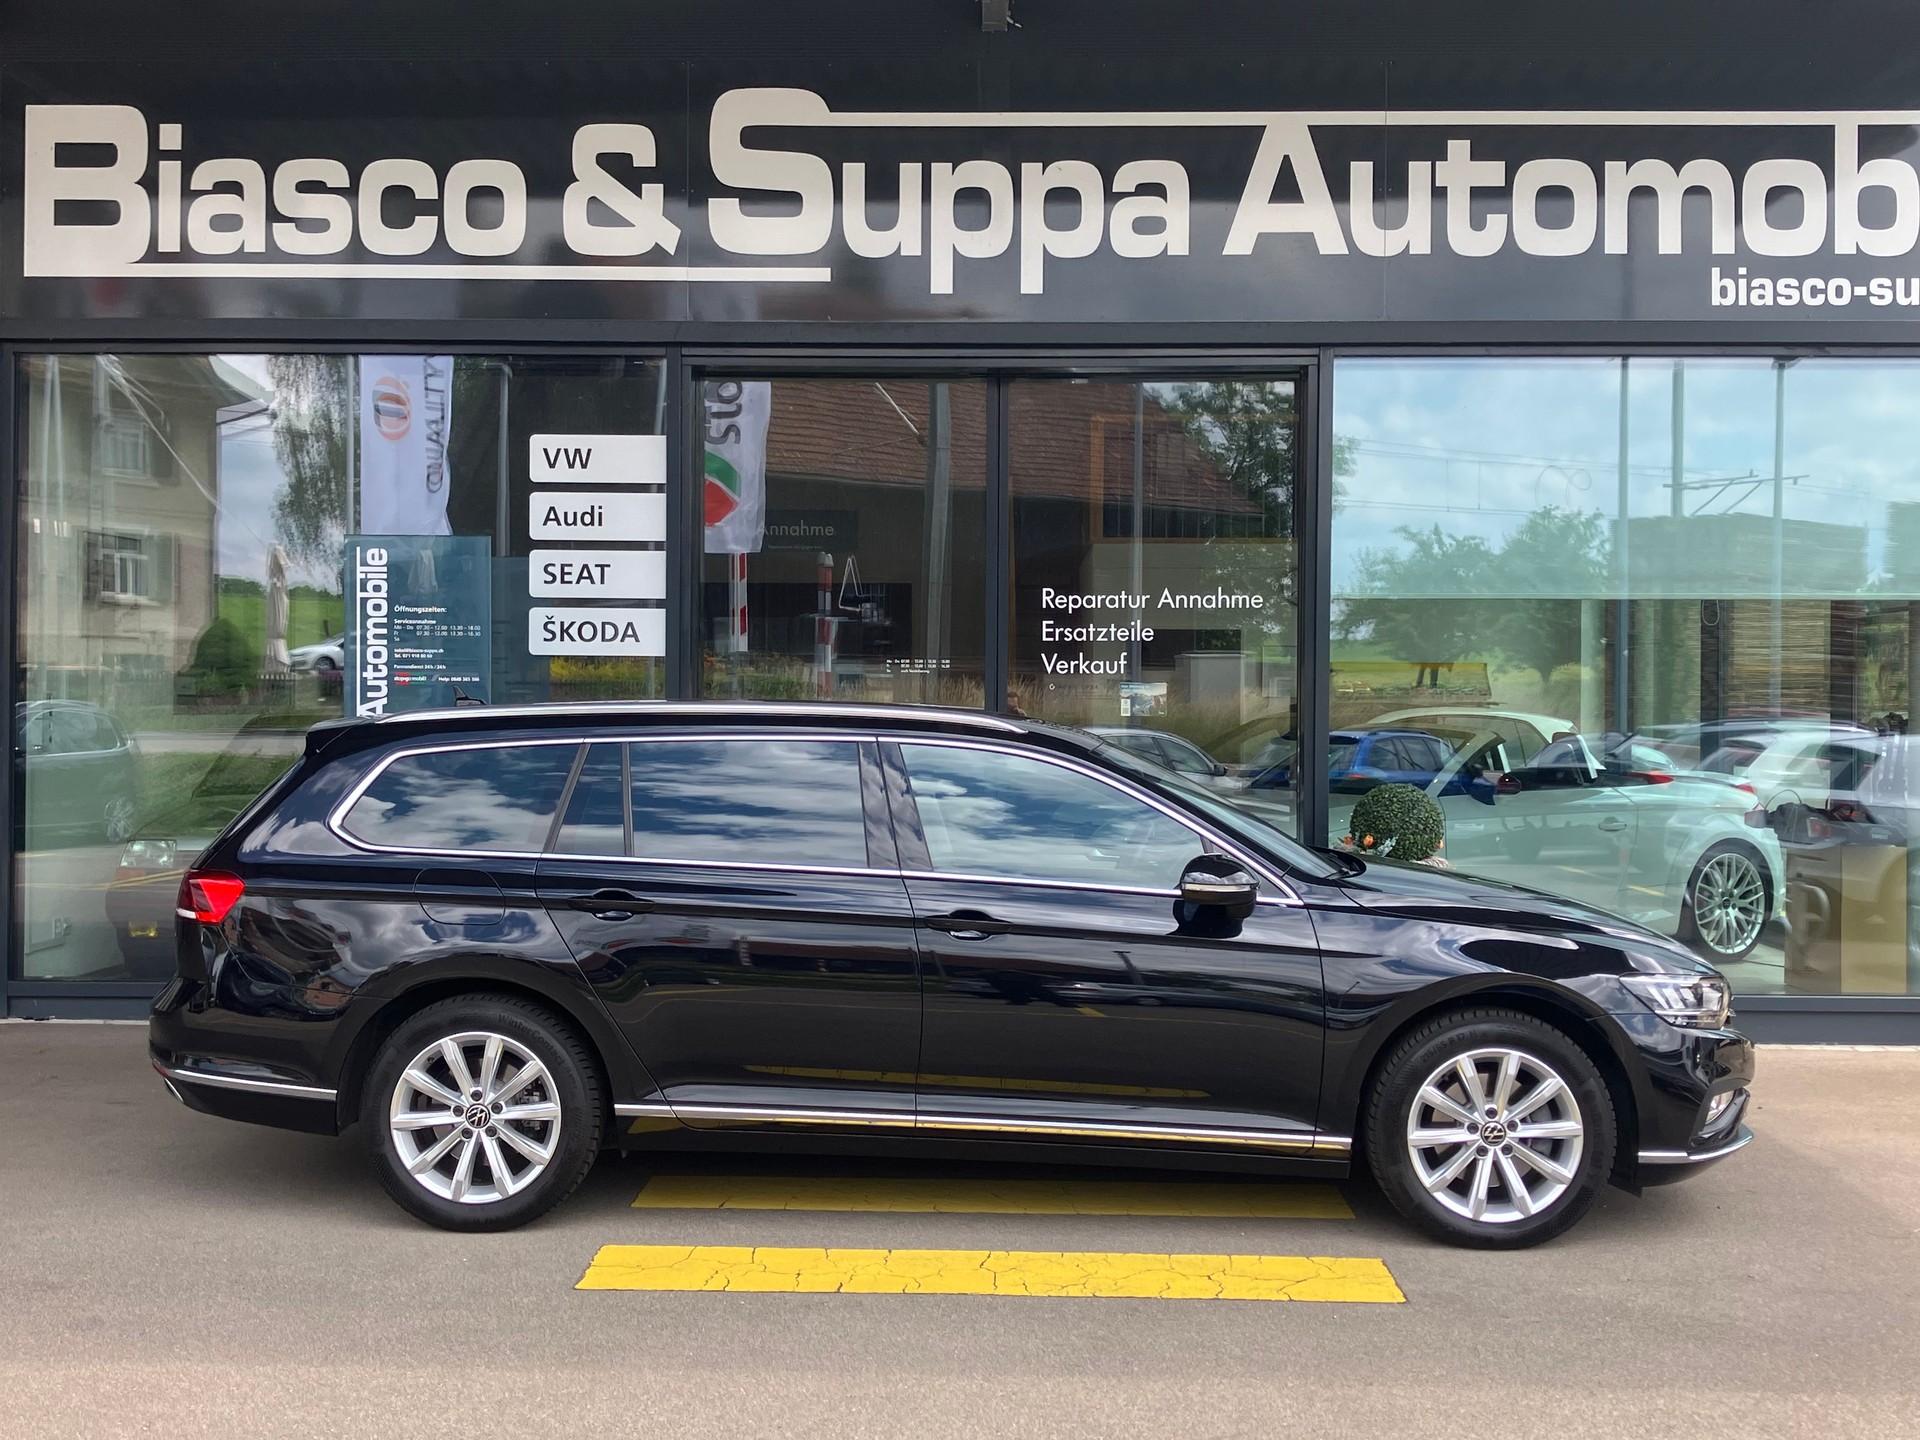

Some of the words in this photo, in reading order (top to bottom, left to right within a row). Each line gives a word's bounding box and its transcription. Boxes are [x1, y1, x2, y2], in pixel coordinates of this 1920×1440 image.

[24, 105, 527, 277] Biasco
[563, 124, 682, 256] &
[708, 88, 1190, 294] Suppa
[1222, 111, 1920, 257] Automob
[543, 448, 592, 469] VW
[542, 505, 603, 527] Audi
[543, 563, 611, 585] SEAT
[1042, 588, 1150, 614] Reparatur
[1157, 586, 1264, 609] Annahme
[357, 548, 388, 718] Automobile
[543, 615, 640, 643] ŠKODA
[1041, 620, 1154, 642] Ersatzteile
[1041, 652, 1127, 674] Verkauf
